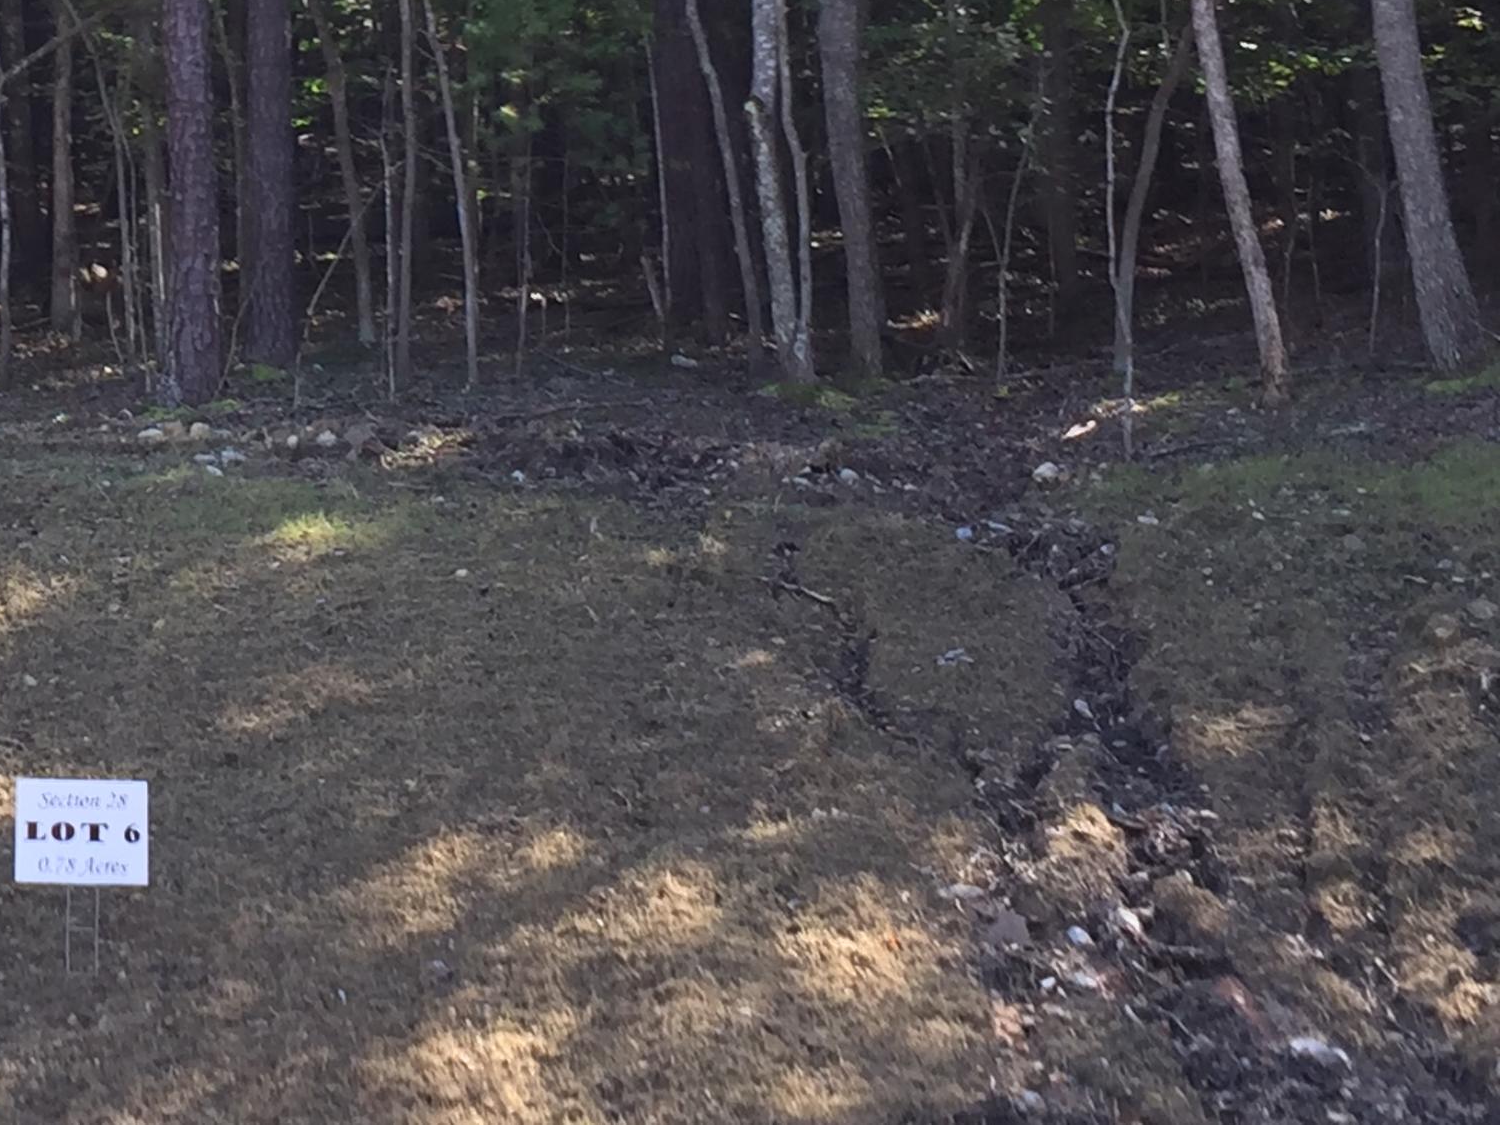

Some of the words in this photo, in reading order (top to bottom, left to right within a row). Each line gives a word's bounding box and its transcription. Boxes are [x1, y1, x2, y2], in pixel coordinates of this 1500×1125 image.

[38, 791, 100, 809] Section
[106, 791, 129, 810] 28
[25, 821, 109, 842] LOT
[124, 822, 140, 843] 6
[38, 856, 77, 874] 0.78
[78, 857, 129, 877] Acres
